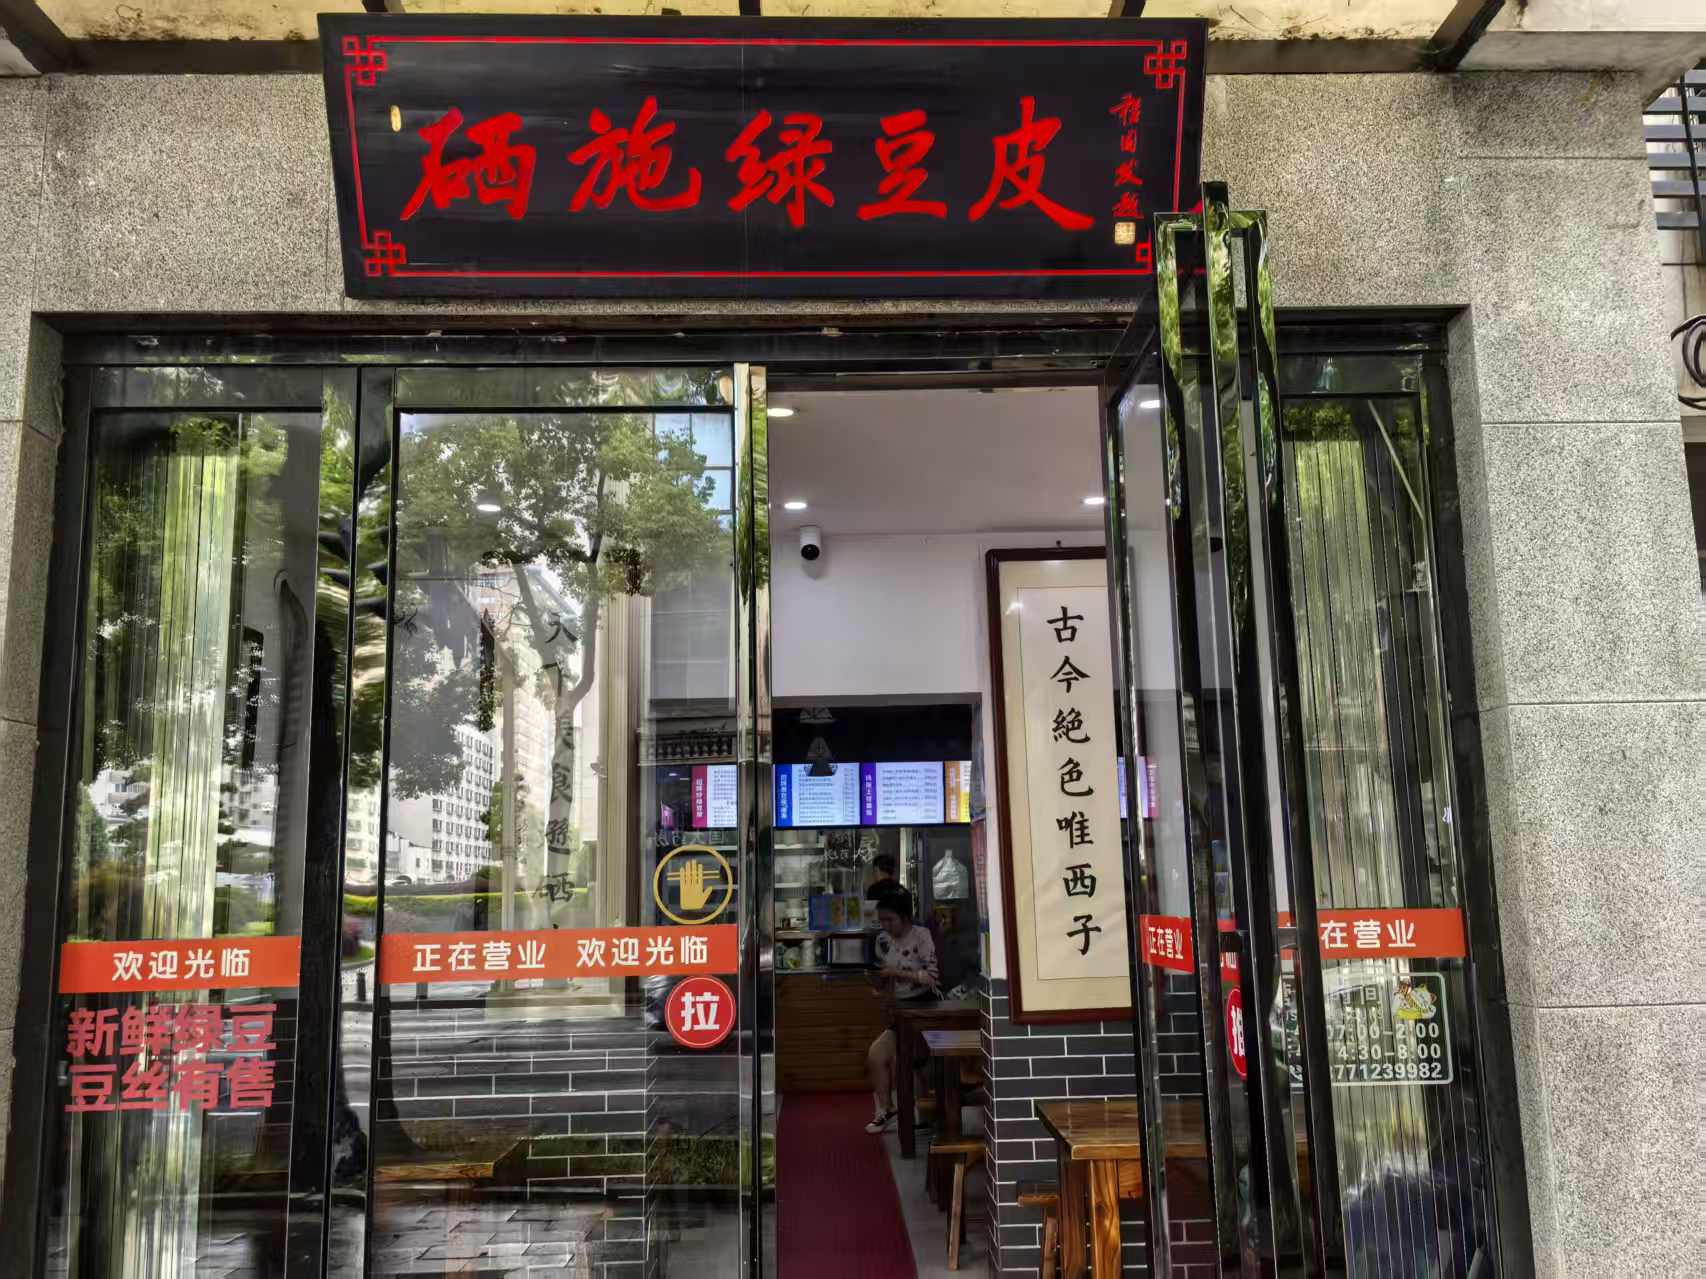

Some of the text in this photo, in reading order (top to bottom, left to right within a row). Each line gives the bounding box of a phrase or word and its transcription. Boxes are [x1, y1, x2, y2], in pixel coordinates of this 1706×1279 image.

[400, 96, 1095, 231] 硒施绿豆皮
[1148, 926, 1184, 960] 正在营业
[1319, 919, 1417, 949] 在营业
[112, 947, 250, 981] 欢迎光临
[412, 935, 708, 972] 正在营业 欢迎光临
[680, 991, 721, 1032] 拉
[65, 1003, 277, 1058] 新鲜绿豆
[64, 1056, 277, 1113] 豆丝有售
[1328, 1062, 1443, 1079] 771239982
